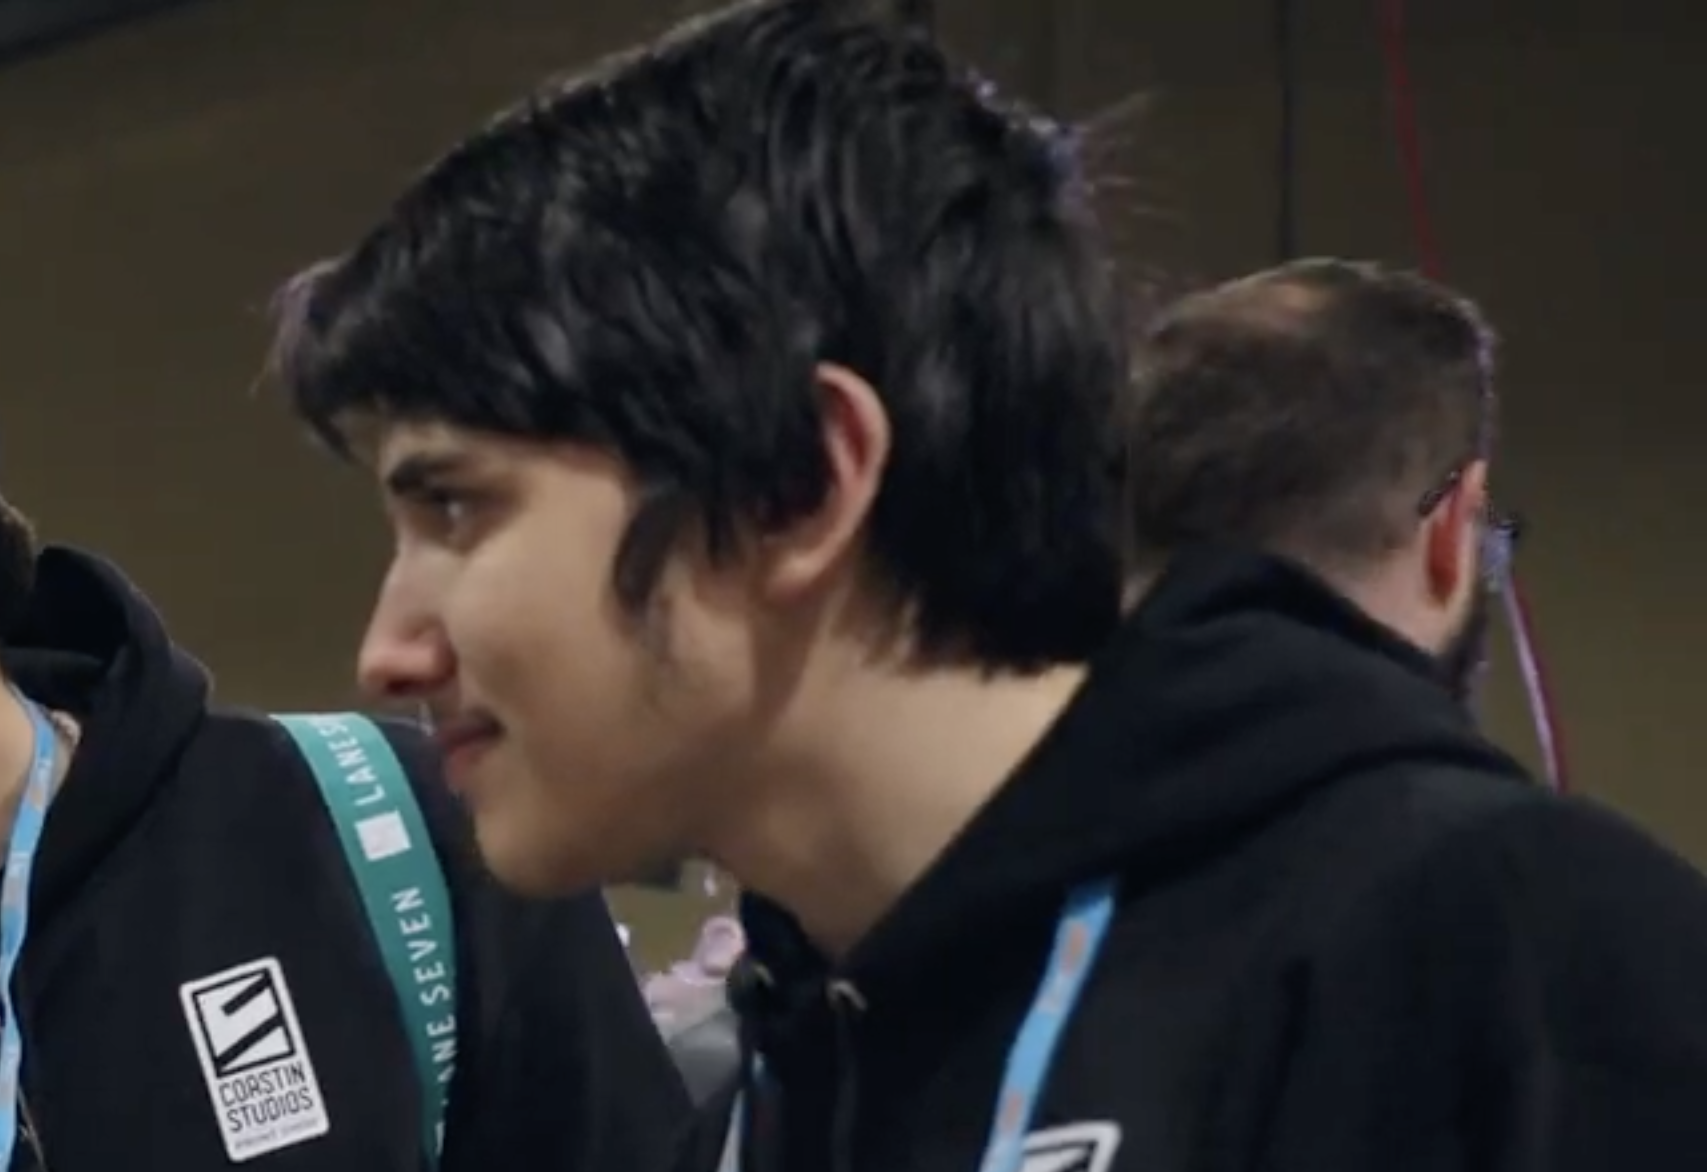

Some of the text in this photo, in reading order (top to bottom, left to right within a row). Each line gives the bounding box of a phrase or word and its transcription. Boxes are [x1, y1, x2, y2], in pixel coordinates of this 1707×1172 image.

[327, 737, 385, 806] LANE
[391, 887, 453, 1007] SEVEN
[226, 1086, 314, 1133] STUDIOS
